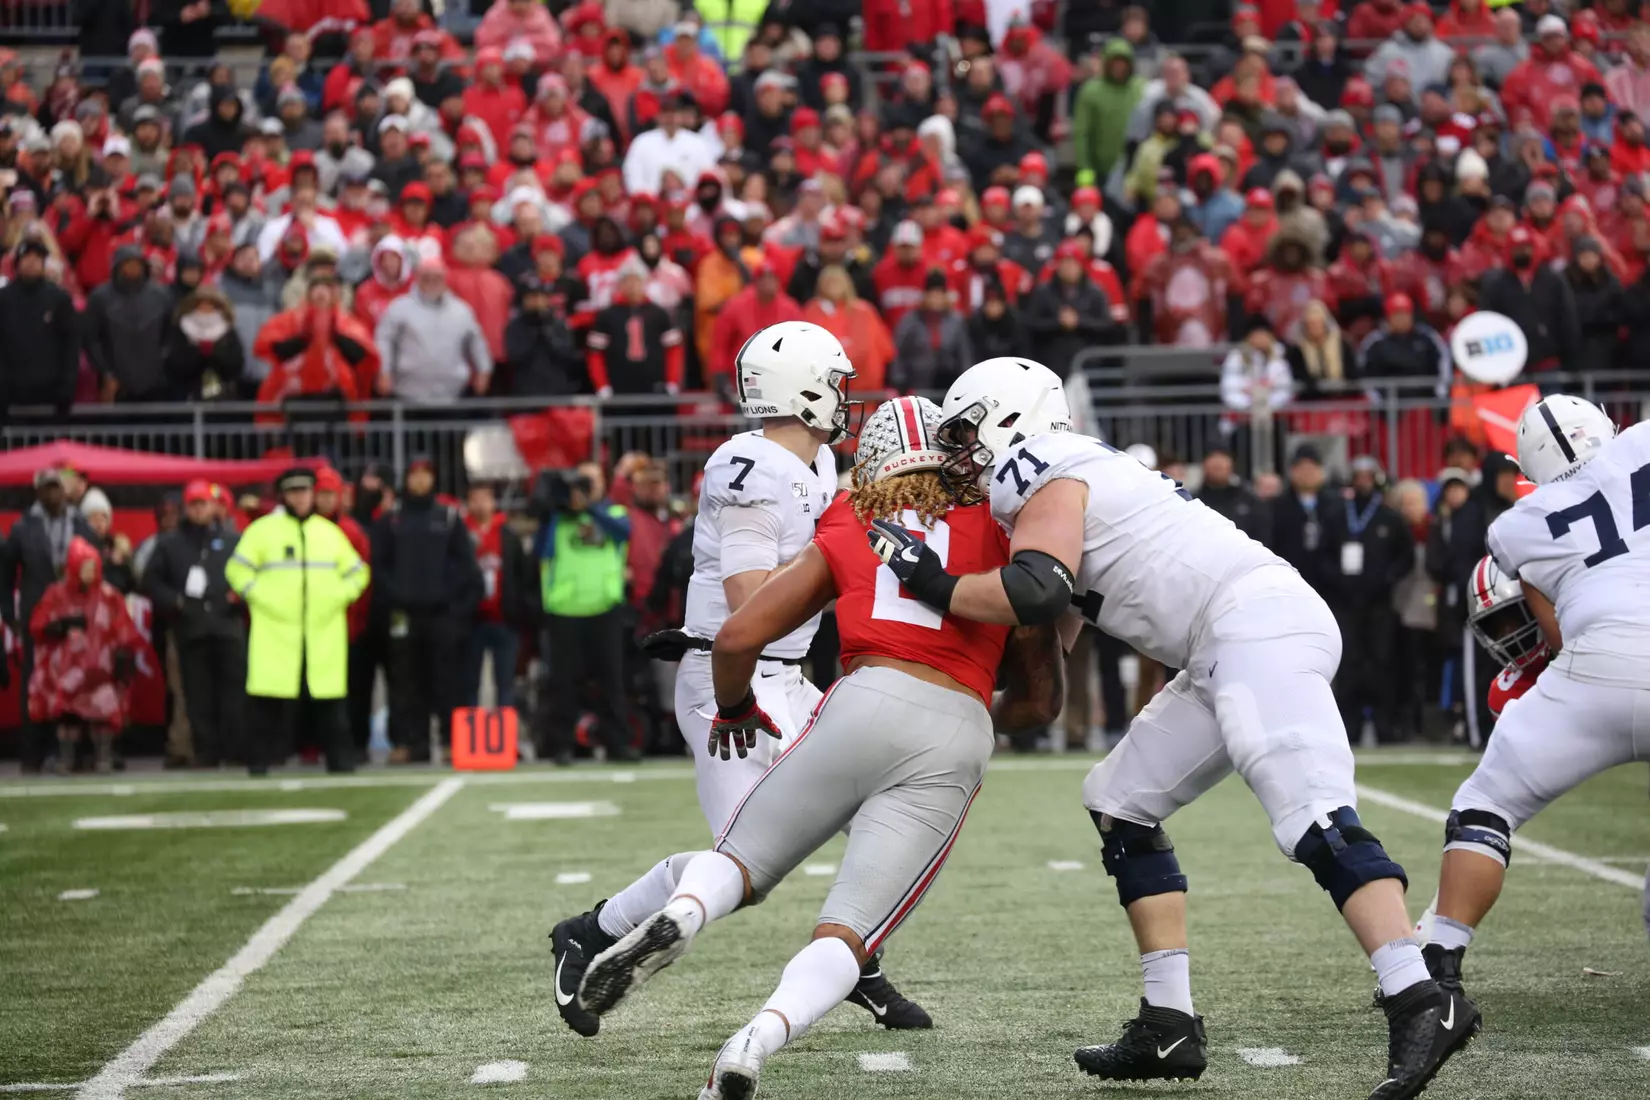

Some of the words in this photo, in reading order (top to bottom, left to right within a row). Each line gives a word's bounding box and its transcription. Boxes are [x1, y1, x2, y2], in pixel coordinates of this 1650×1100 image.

[625, 315, 647, 361] 1
[751, 406, 778, 414] LIONS
[728, 456, 756, 492] 7
[995, 447, 1050, 497] 71
[871, 509, 950, 631] 2
[465, 710, 504, 754] 10
